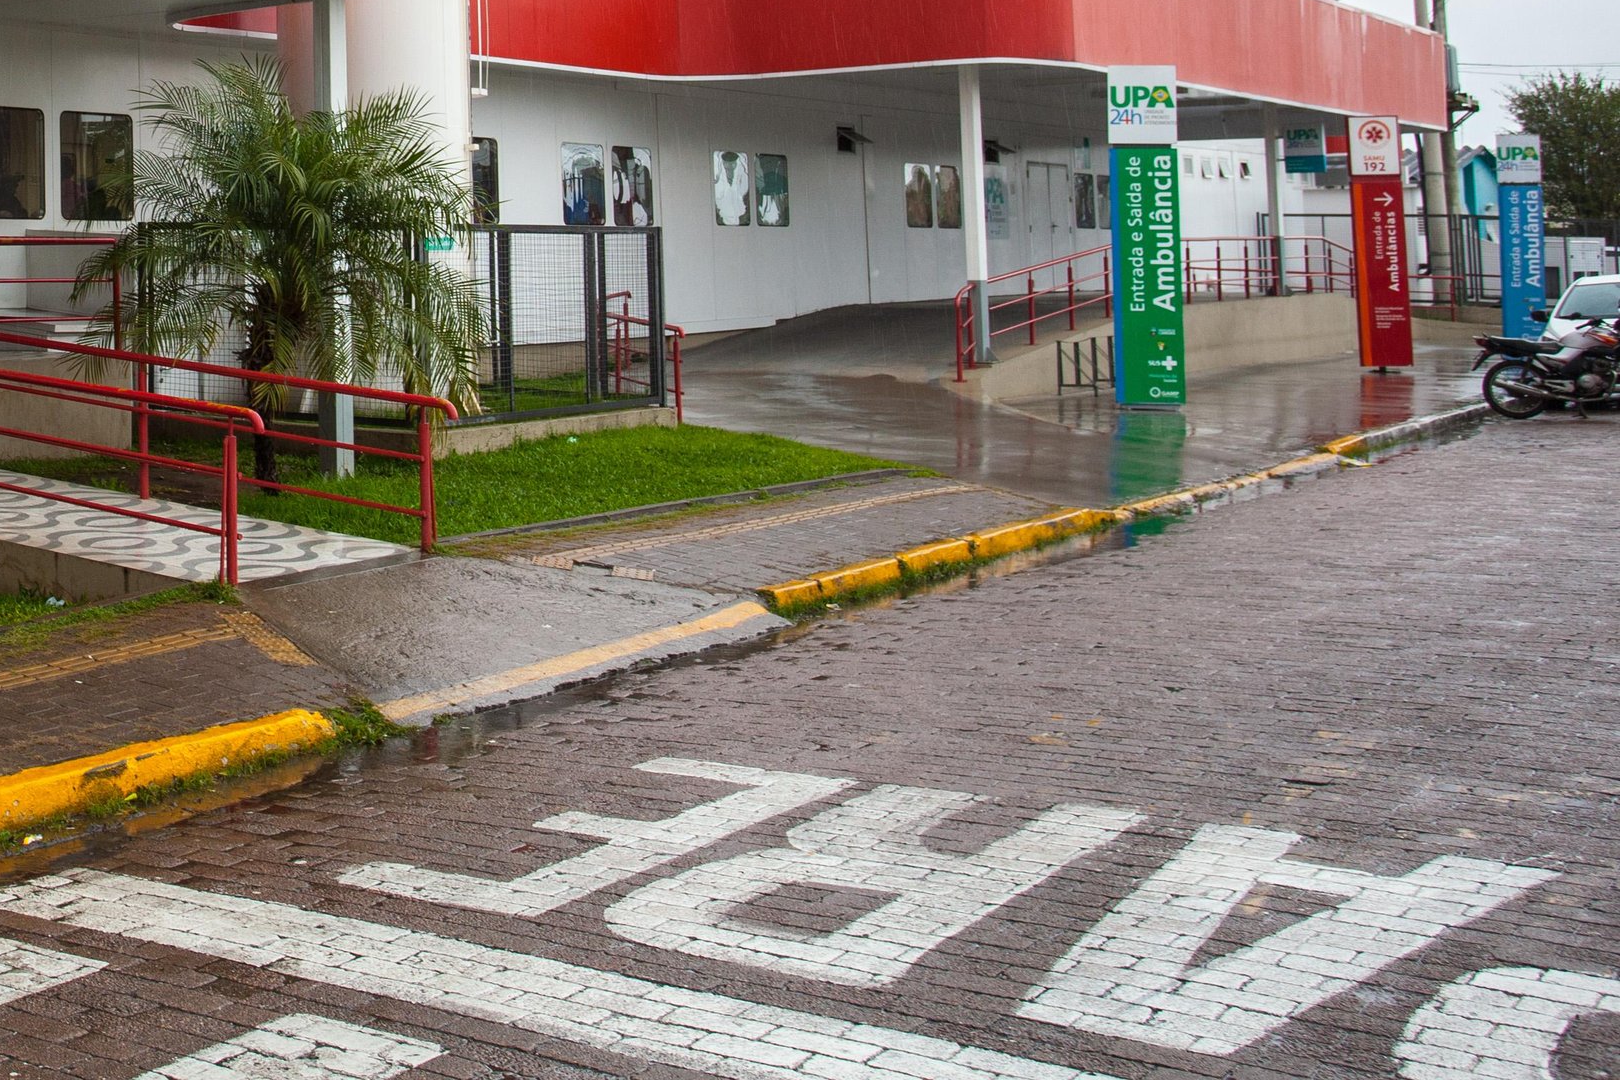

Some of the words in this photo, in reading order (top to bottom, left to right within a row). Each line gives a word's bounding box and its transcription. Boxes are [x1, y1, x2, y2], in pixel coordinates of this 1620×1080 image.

[1110, 86, 1175, 108] UPA
[1110, 109, 1142, 125] 24h
[1497, 147, 1538, 160] UPA
[1125, 156, 1141, 177] de
[1364, 162, 1386, 171] 192
[1126, 183, 1143, 227] Saída
[1508, 191, 1519, 204] de
[1373, 211, 1381, 223] de
[1131, 232, 1144, 242] e
[1147, 155, 1176, 312] Ambulância
[1373, 226, 1384, 260] Entrada
[1512, 237, 1520, 245] e
[1523, 190, 1540, 288] Ambulância
[1385, 211, 1400, 292] Ambulâncias
[1128, 247, 1146, 312] Entrada
[1509, 251, 1522, 288] Entrada
